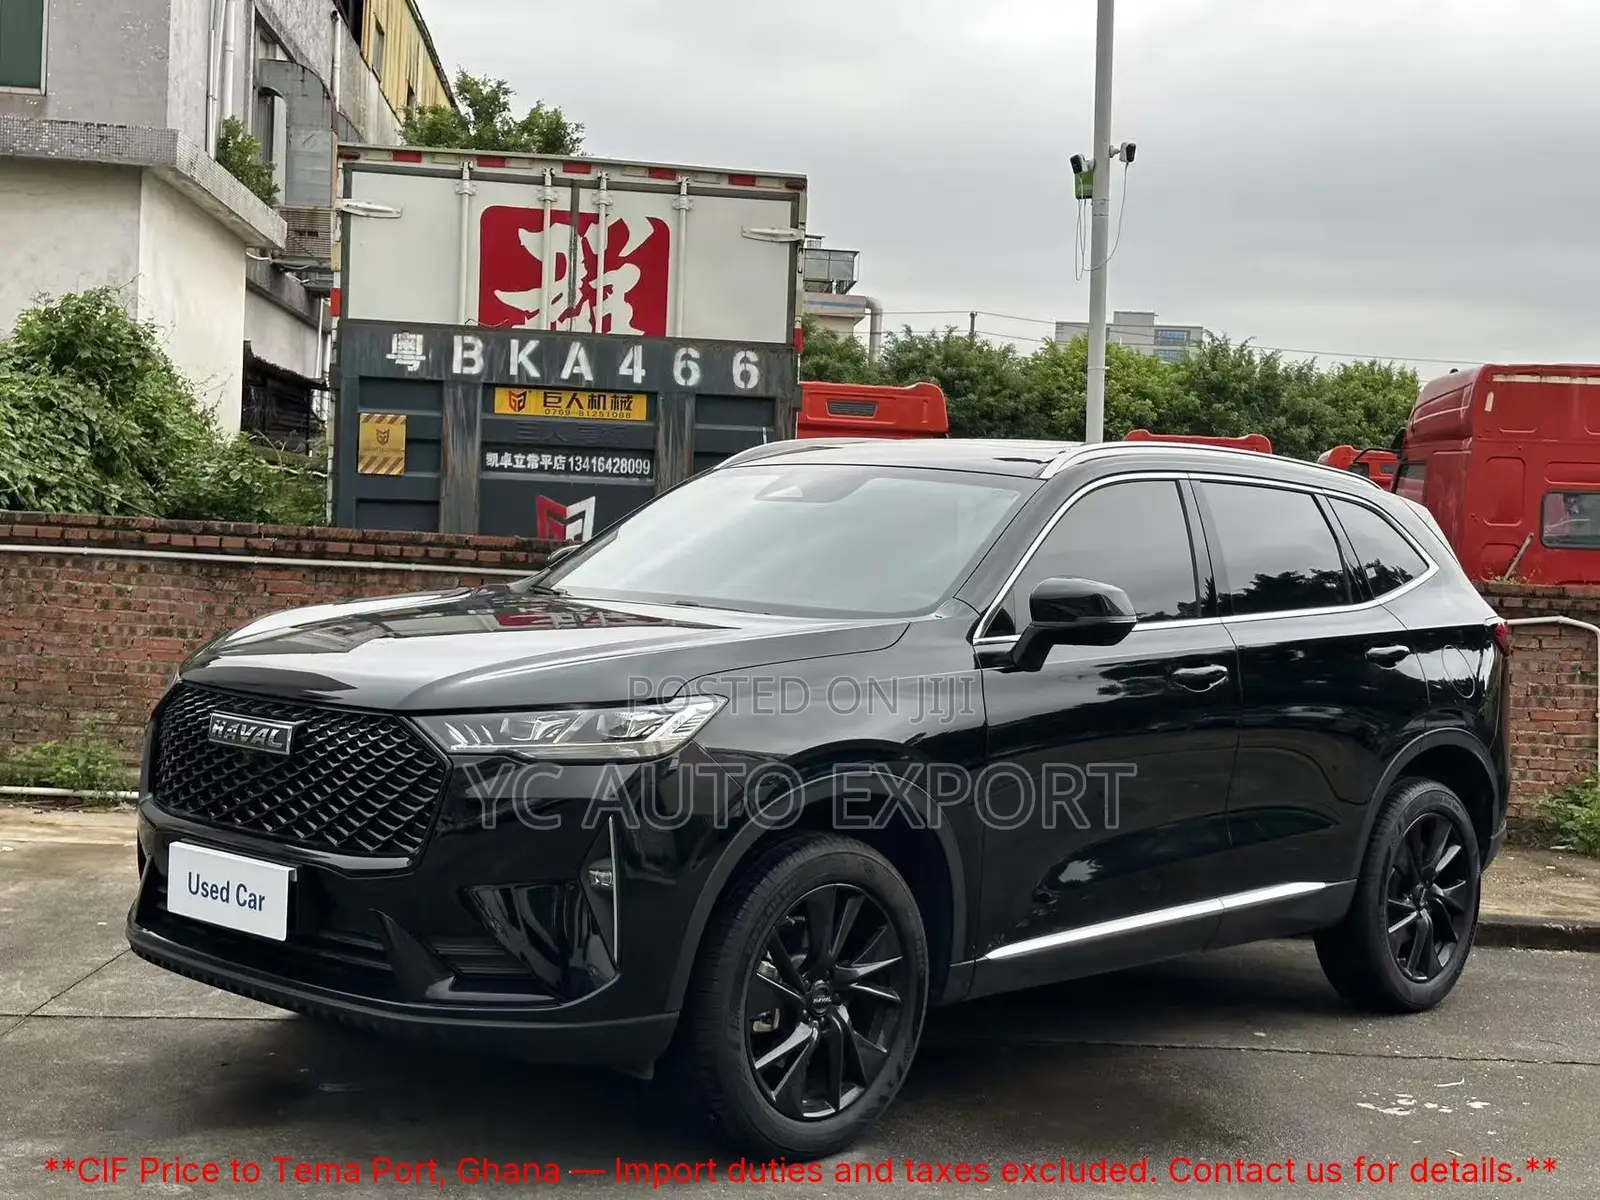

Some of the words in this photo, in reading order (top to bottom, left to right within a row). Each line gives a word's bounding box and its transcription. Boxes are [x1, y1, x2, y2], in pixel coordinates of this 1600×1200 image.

[542, 391, 633, 412] 巨人机械
[568, 455, 651, 475] 13416428099
[211, 719, 285, 748] HAVAL
[187, 871, 230, 904] Used
[235, 883, 266, 912] Car
